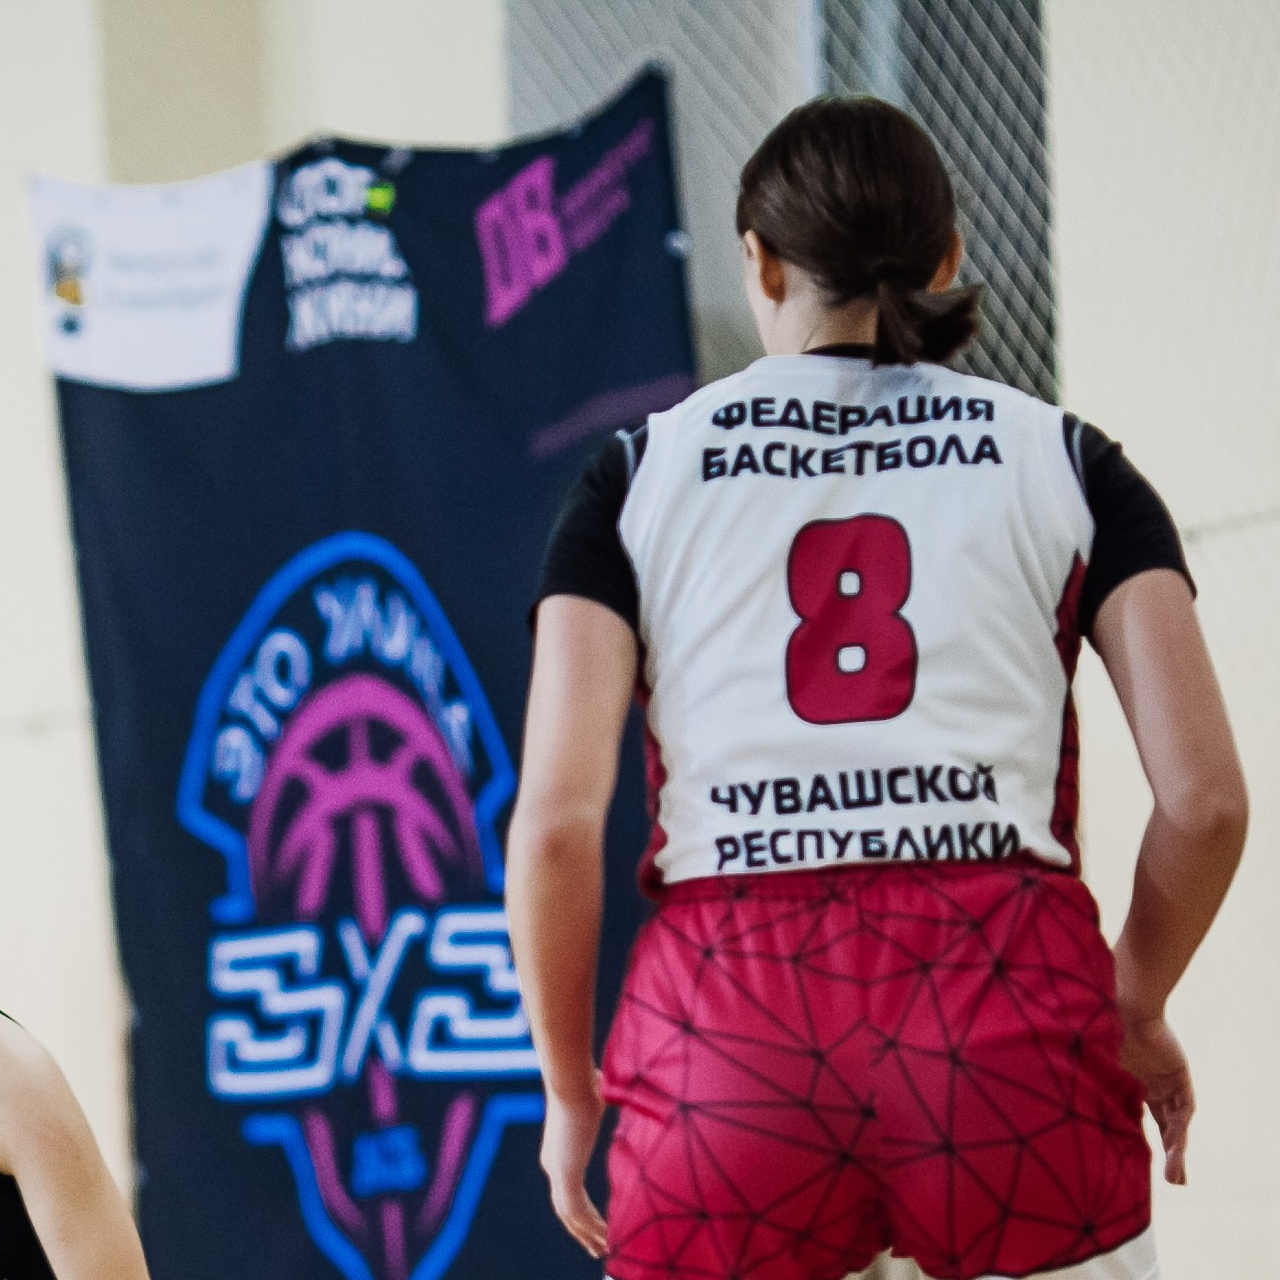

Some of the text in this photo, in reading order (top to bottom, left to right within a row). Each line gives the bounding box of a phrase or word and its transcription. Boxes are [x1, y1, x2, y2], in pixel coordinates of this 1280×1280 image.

[712, 395, 995, 435] ФЕДЕРАЦИЯ
[702, 435, 1003, 482] БАСКЕТБОЛА
[786, 512, 918, 725] 8
[710, 764, 999, 815] ЧУВАШСКОЙ
[715, 823, 1021, 871] РЕСПУБЛИКИ
